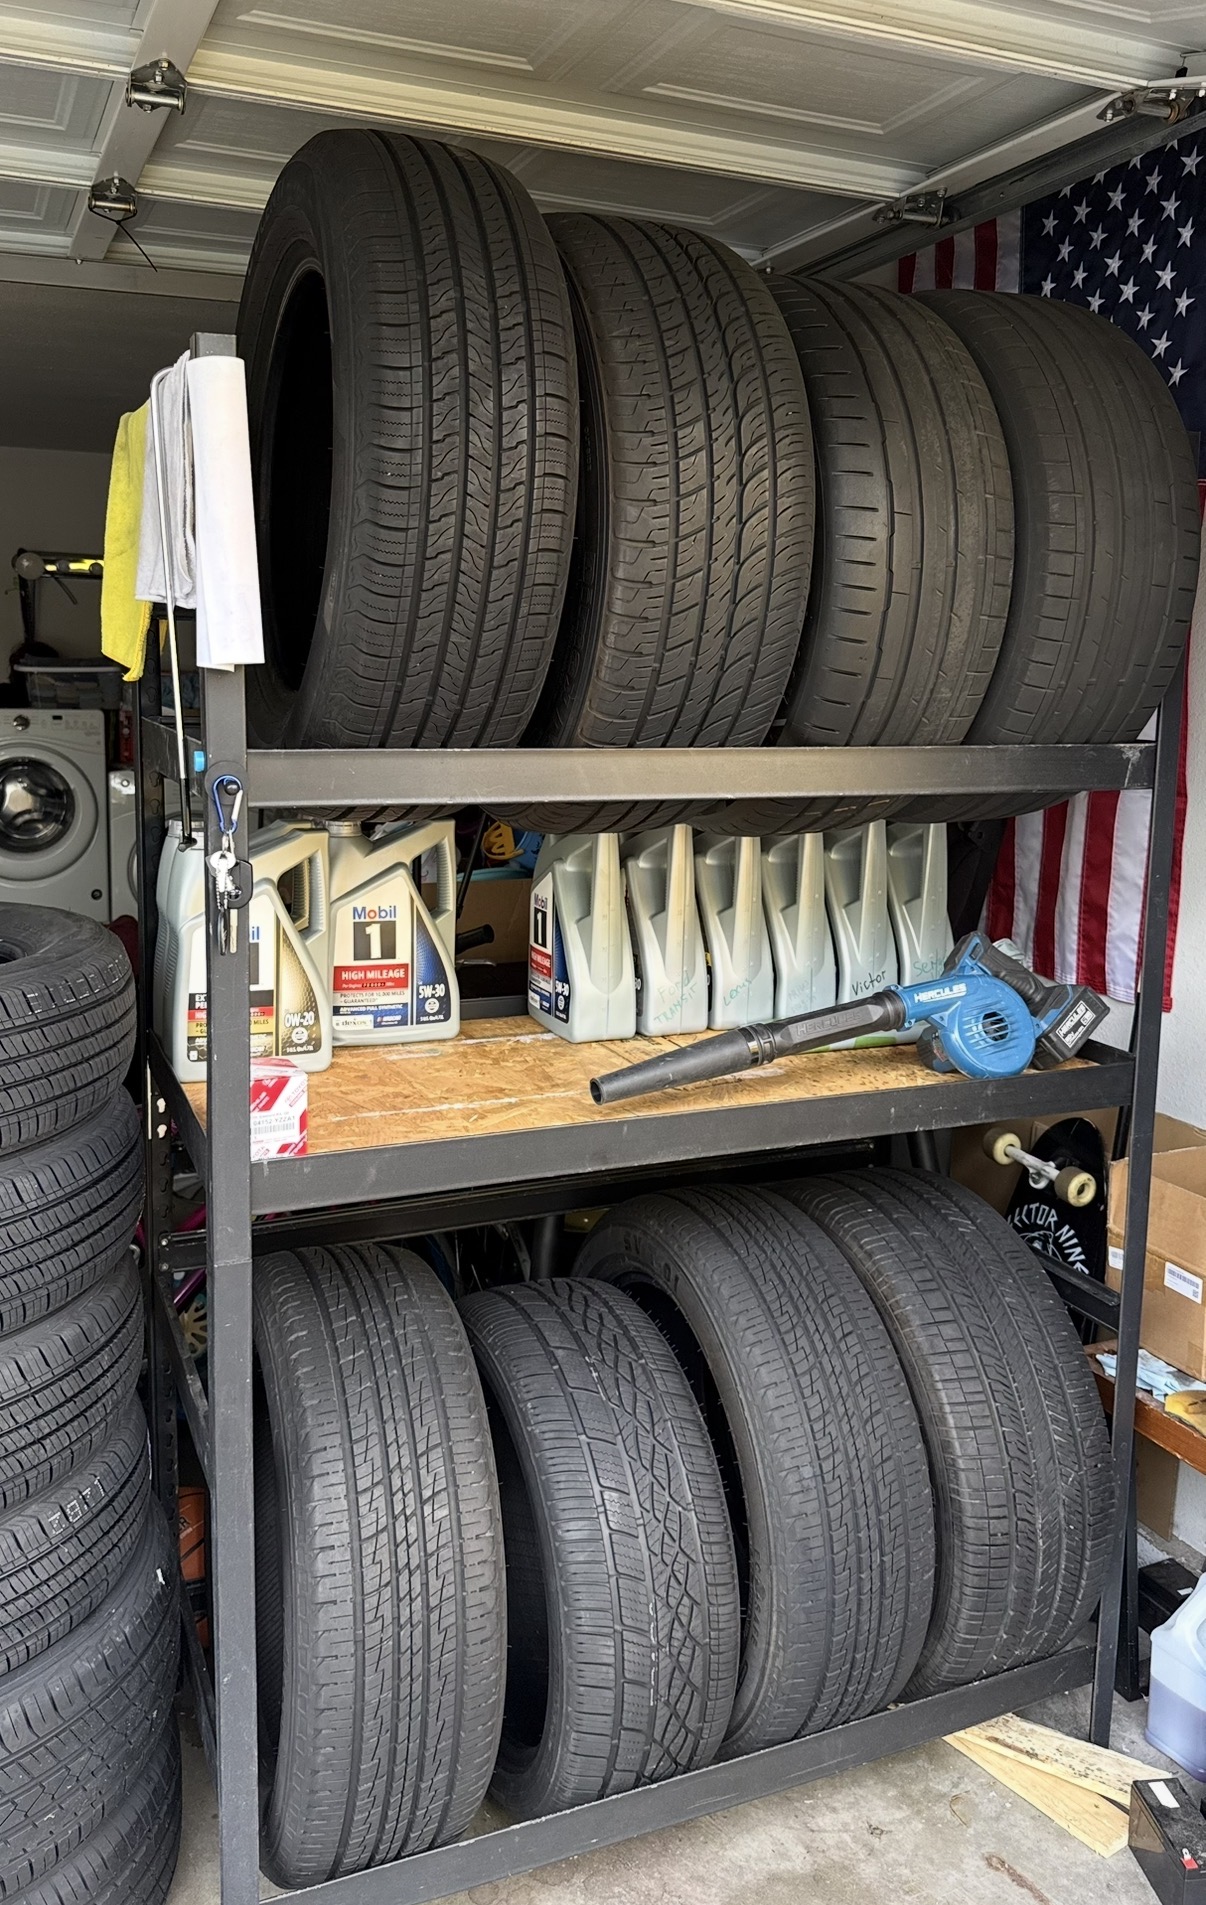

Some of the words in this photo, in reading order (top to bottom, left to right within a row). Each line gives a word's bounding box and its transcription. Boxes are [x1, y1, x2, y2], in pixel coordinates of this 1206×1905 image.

[534, 893, 548, 910] Mobil
[353, 905, 397, 920] Mobil
[365, 923, 382, 959] 1
[341, 970, 364, 980] HIGH
[366, 968, 405, 979] MILEAGE
[852, 970, 886, 996] Victor
[418, 983, 446, 999] 5W-30
[657, 970, 690, 1002] Ford
[723, 977, 753, 1007] Lexus
[913, 983, 968, 1003] HERCULES
[284, 1011, 315, 1028] 0W-20
[797, 1012, 860, 1037] HERCULES
